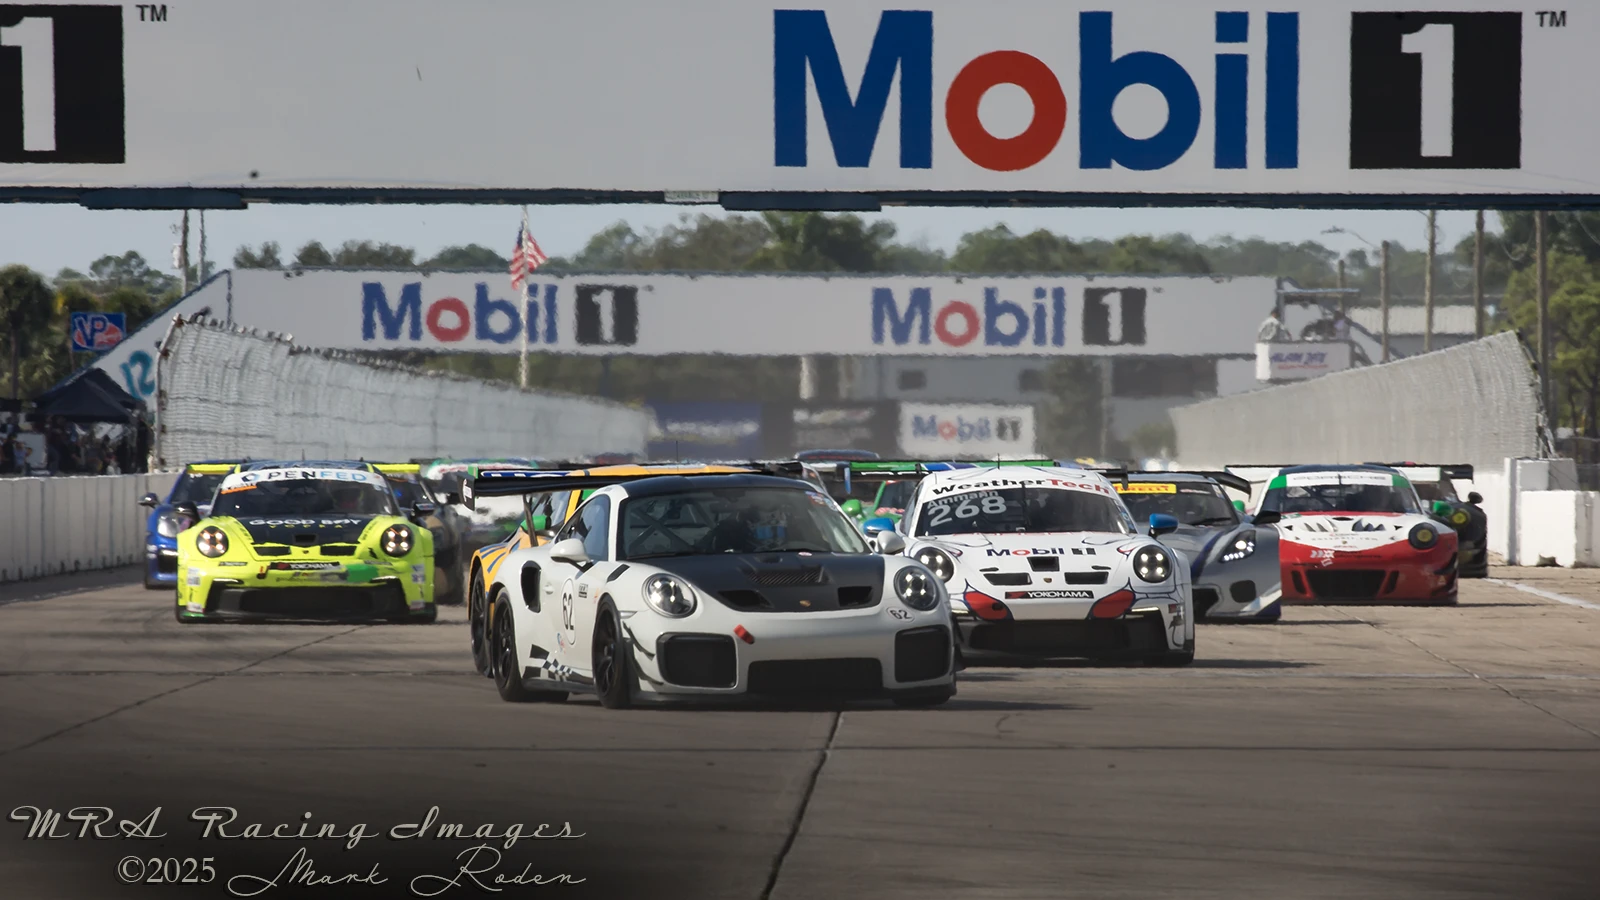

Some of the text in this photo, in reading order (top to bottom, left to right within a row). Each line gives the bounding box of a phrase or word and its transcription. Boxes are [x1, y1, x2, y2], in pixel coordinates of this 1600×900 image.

[0, 4, 168, 152] 1 TM
[774, 10, 1567, 171] Mobil 1 TM
[361, 281, 559, 344] Mobil
[871, 286, 1067, 347] Mobil
[75, 315, 109, 348] VP
[912, 415, 991, 442] Mobil
[268, 471, 367, 481] PENFED
[932, 478, 1110, 495] WeatherTech
[927, 490, 999, 510] Ammann
[928, 496, 1008, 528] 268
[986, 548, 1065, 557] Mobil
[562, 592, 575, 631] 62
[889, 609, 912, 620] 62
